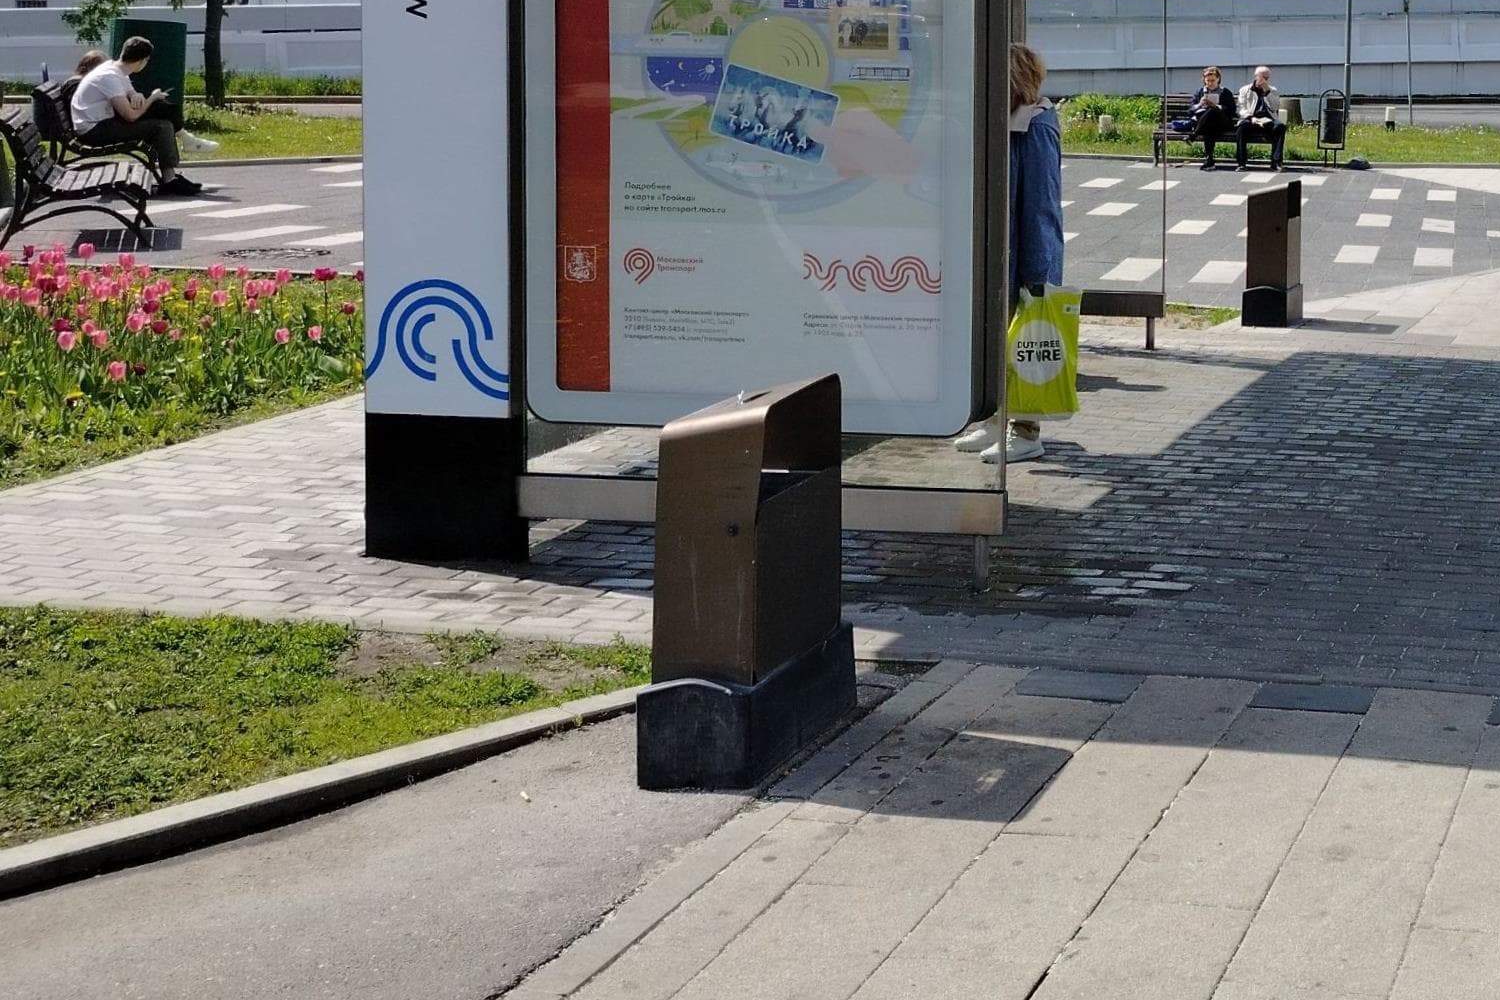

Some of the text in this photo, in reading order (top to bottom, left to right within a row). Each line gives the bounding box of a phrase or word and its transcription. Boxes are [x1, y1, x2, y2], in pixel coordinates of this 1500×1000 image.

[728, 114, 808, 149] ТРОЙКА
[624, 181, 672, 191] Подробнее
[632, 194, 655, 202] карте
